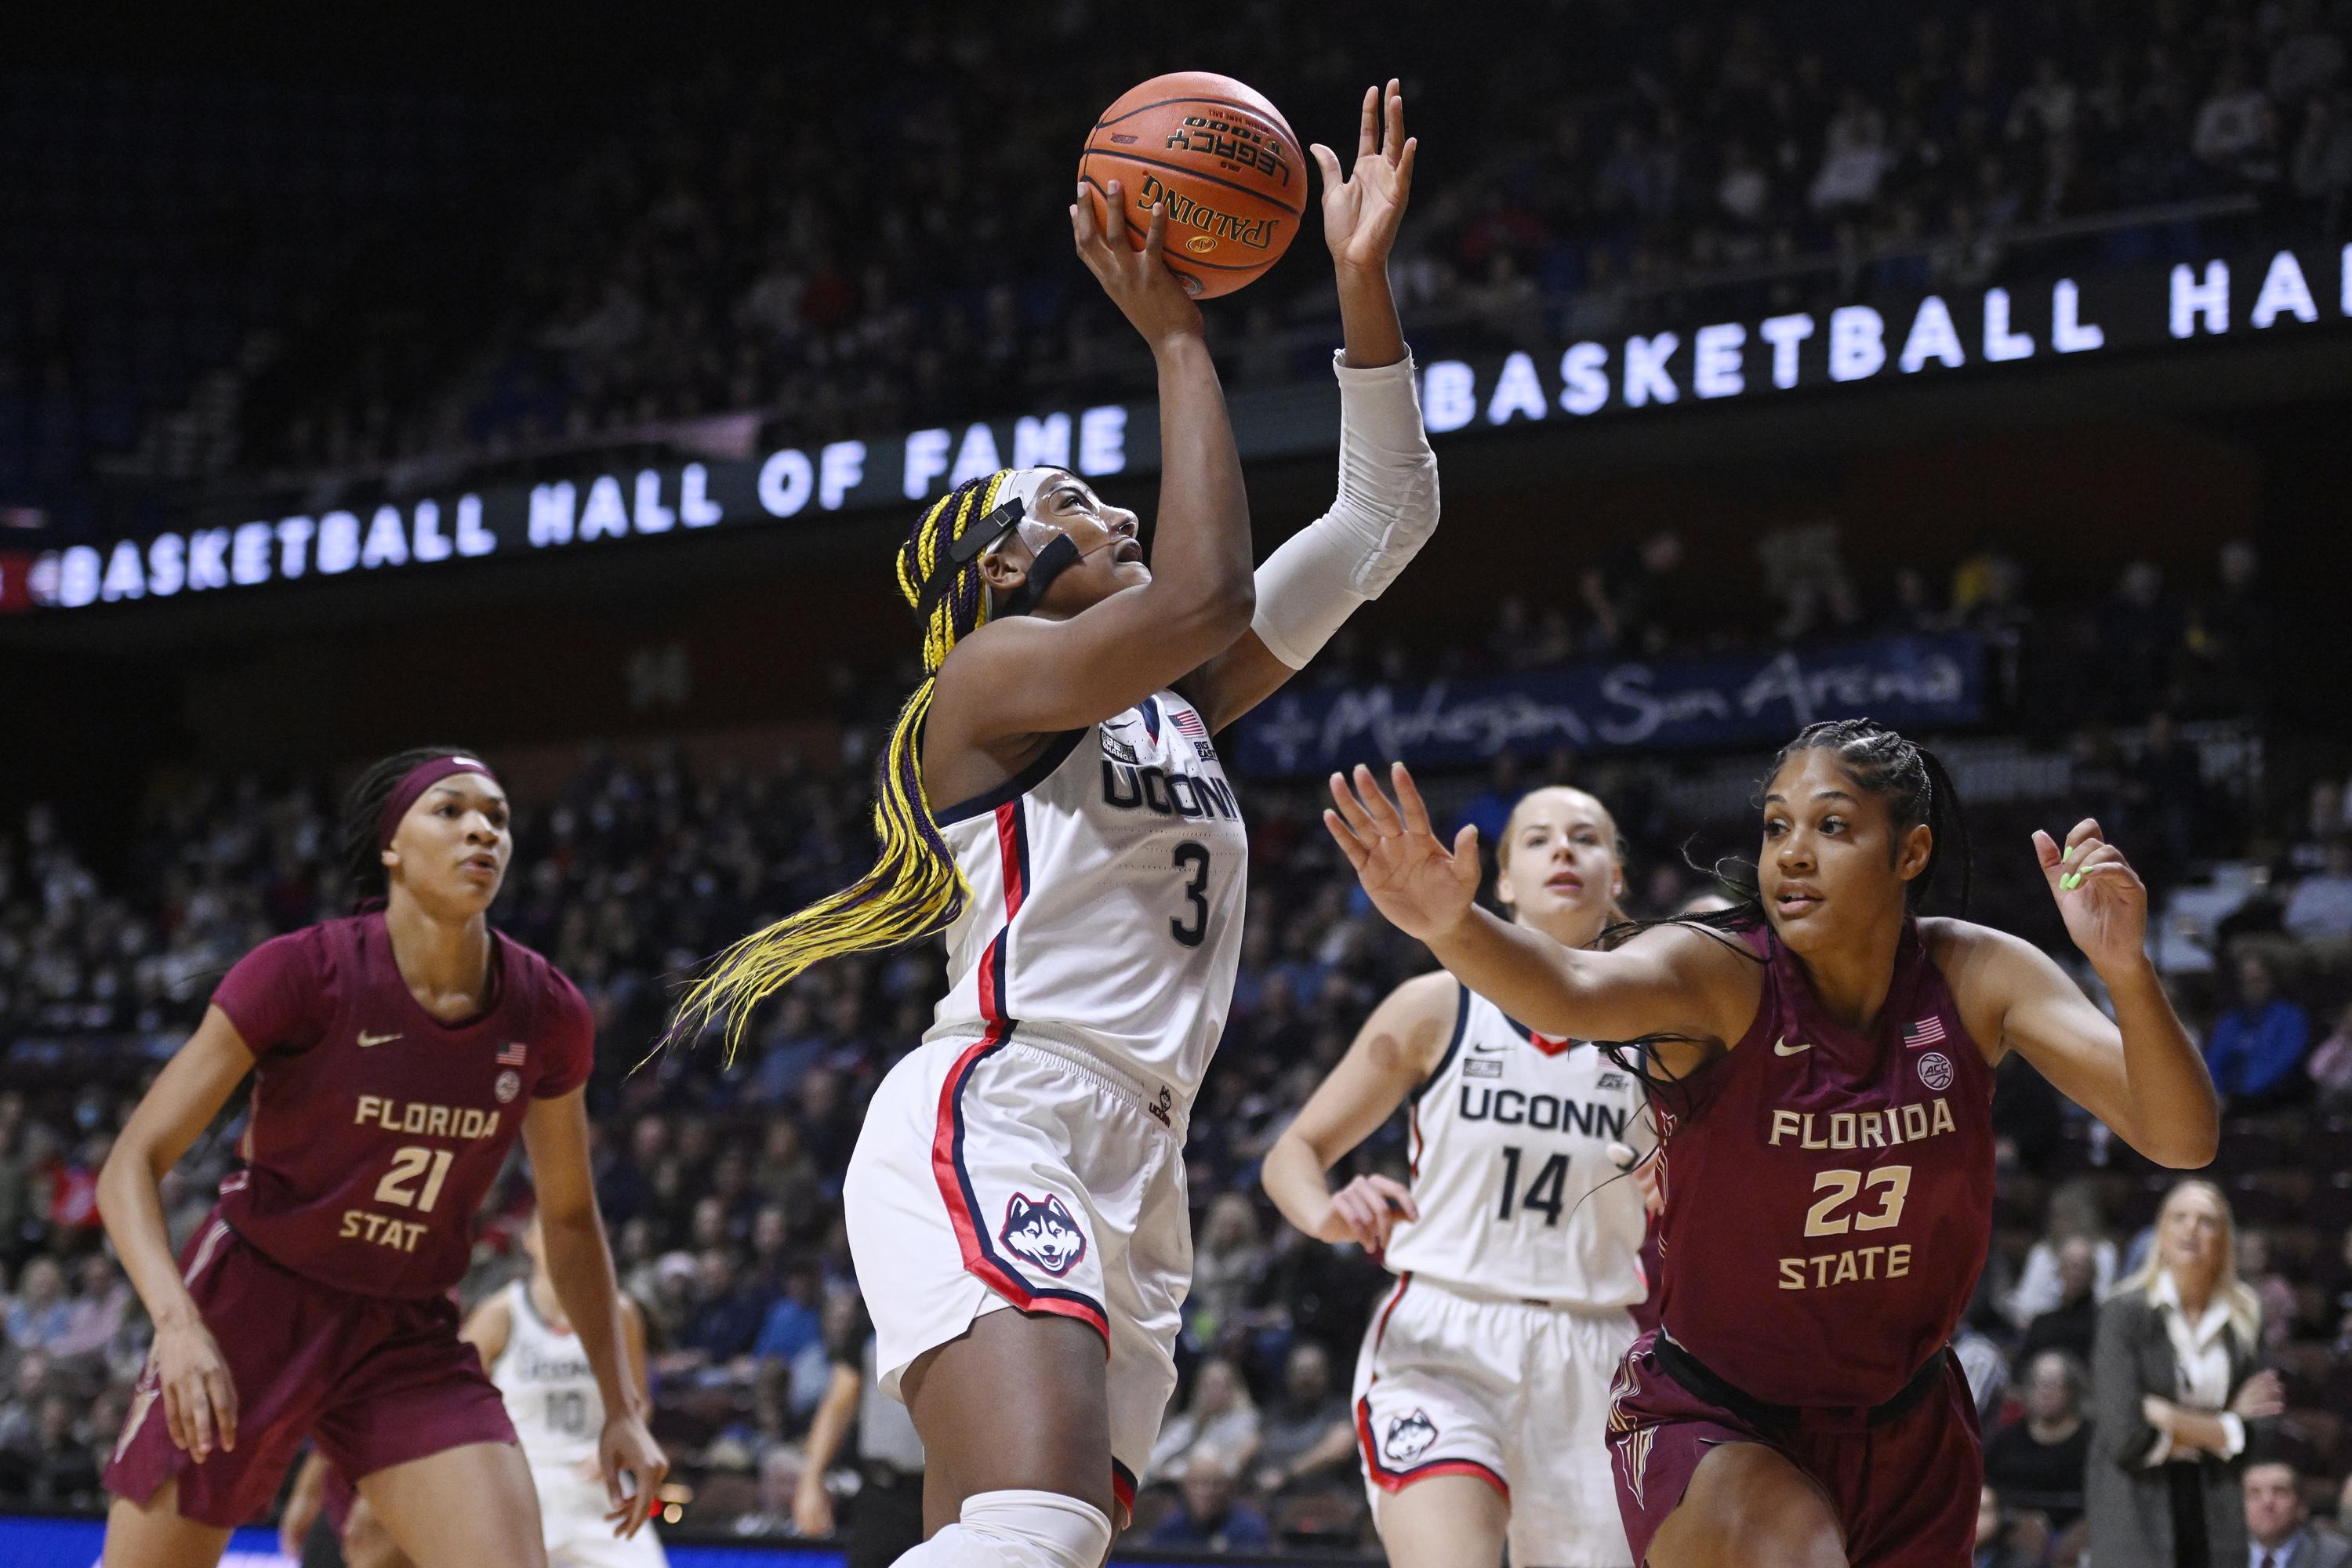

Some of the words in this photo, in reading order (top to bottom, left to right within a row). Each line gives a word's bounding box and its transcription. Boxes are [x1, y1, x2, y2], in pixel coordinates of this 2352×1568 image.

[1166, 129, 1290, 187] LEGACY
[1182, 116, 1262, 145] 1000
[1137, 175, 1280, 250] SPALDING
[1425, 279, 2103, 434] BASKETBALL
[2169, 244, 2352, 339] HA
[58, 495, 495, 607] BASKETBALL
[528, 464, 722, 546] HALL
[758, 441, 866, 517] OF
[904, 405, 1127, 500] FAME
[1596, 663, 1728, 745] Sun
[1739, 651, 1964, 726] Arena
[1102, 742, 1135, 762] CHANGE
[1193, 740, 1210, 750] BIG
[1169, 840, 1211, 949] 3
[1925, 1062, 1949, 1075] ACC
[354, 1094, 501, 1139] FLORIDA
[1459, 1085, 1627, 1139] UCONN
[1768, 1098, 1957, 1150] FLORIDA
[373, 1145, 455, 1213] 21
[1497, 1146, 1572, 1228] 14
[1804, 1165, 1912, 1237] 23
[1778, 1244, 1912, 1290] STATE
